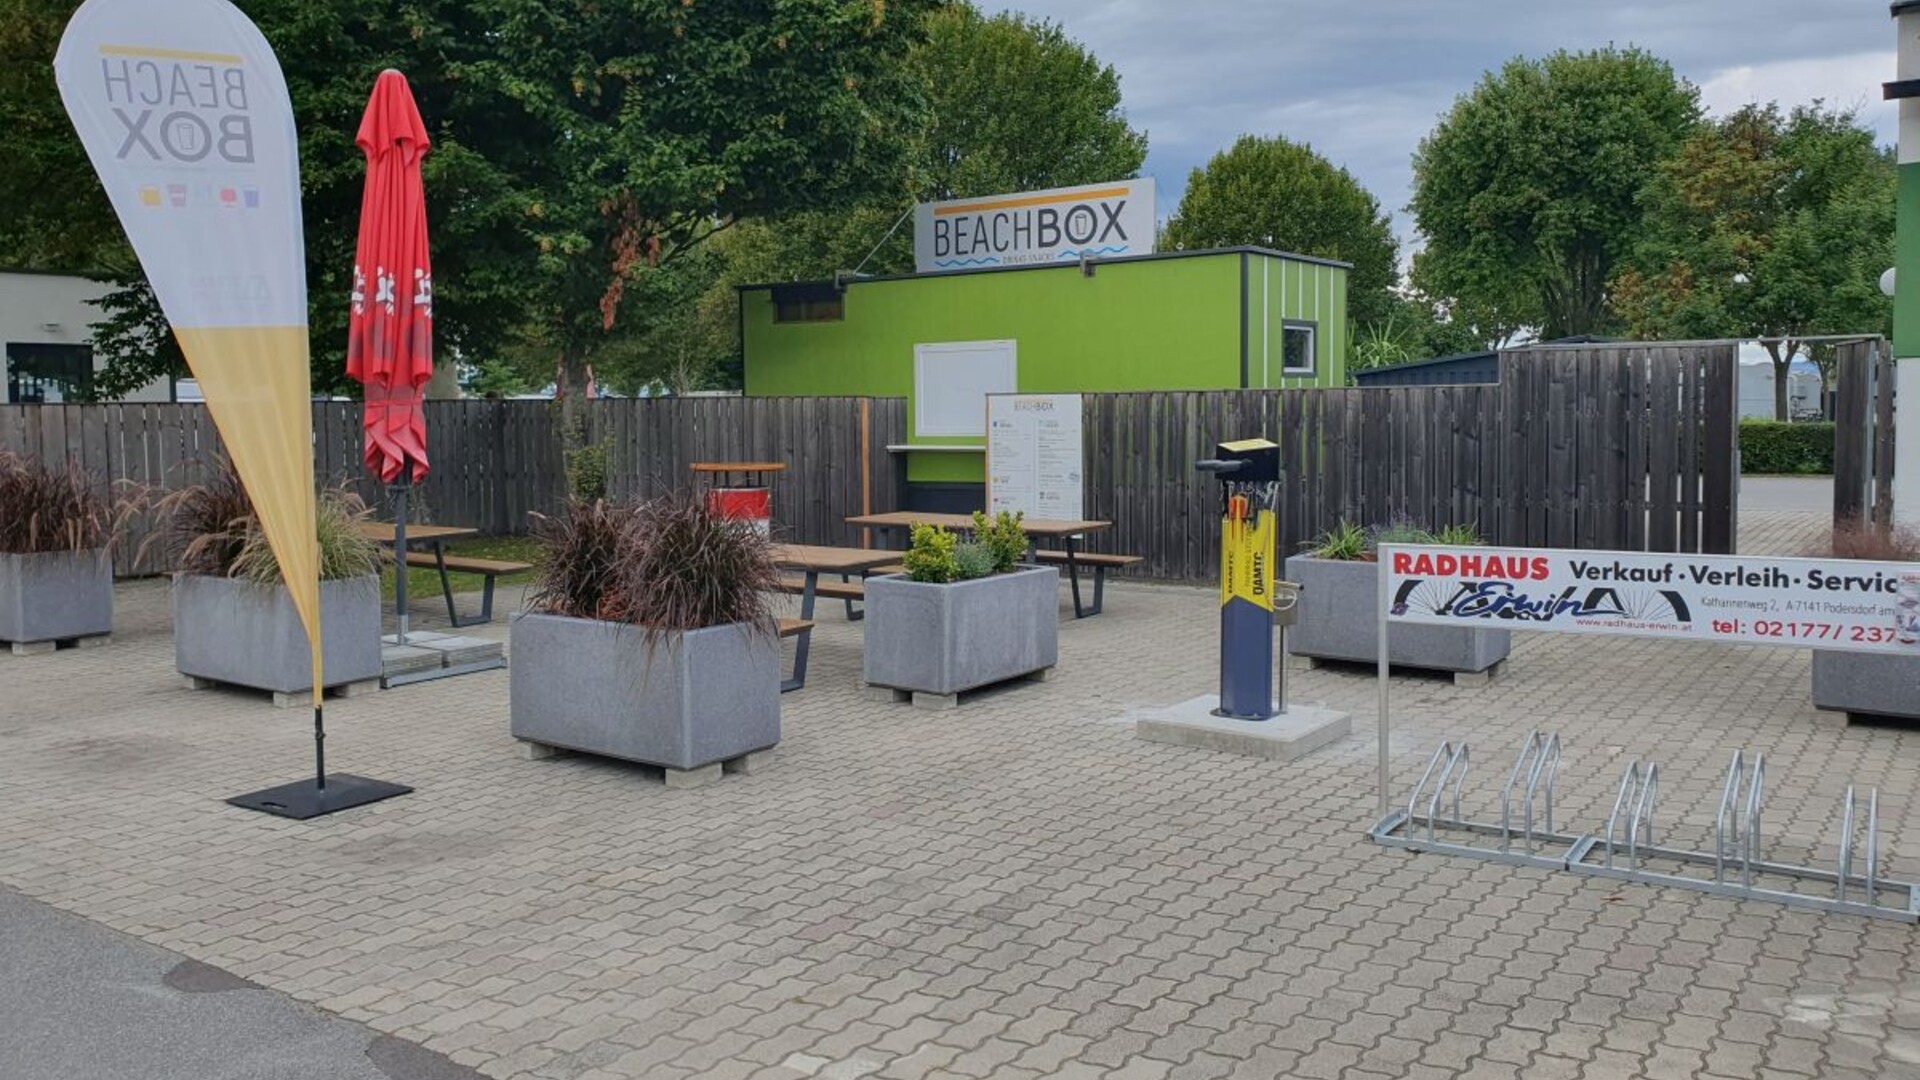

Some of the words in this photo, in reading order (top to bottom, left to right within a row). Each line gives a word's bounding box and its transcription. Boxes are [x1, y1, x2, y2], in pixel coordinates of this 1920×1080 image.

[934, 200, 1128, 258] BEACHBOX
[1394, 552, 1550, 581] RADHAUS
[1569, 560, 1674, 583] Verkauf
[1688, 565, 1790, 589] Verleih
[1807, 569, 1898, 594] Servic
[1453, 581, 1624, 618] Erwin
[1823, 602, 1877, 615] Podersdorf
[1878, 606, 1896, 617] am
[1575, 618, 1693, 632] www.radhaus-erwin.at
[1712, 619, 1747, 635] tel:
